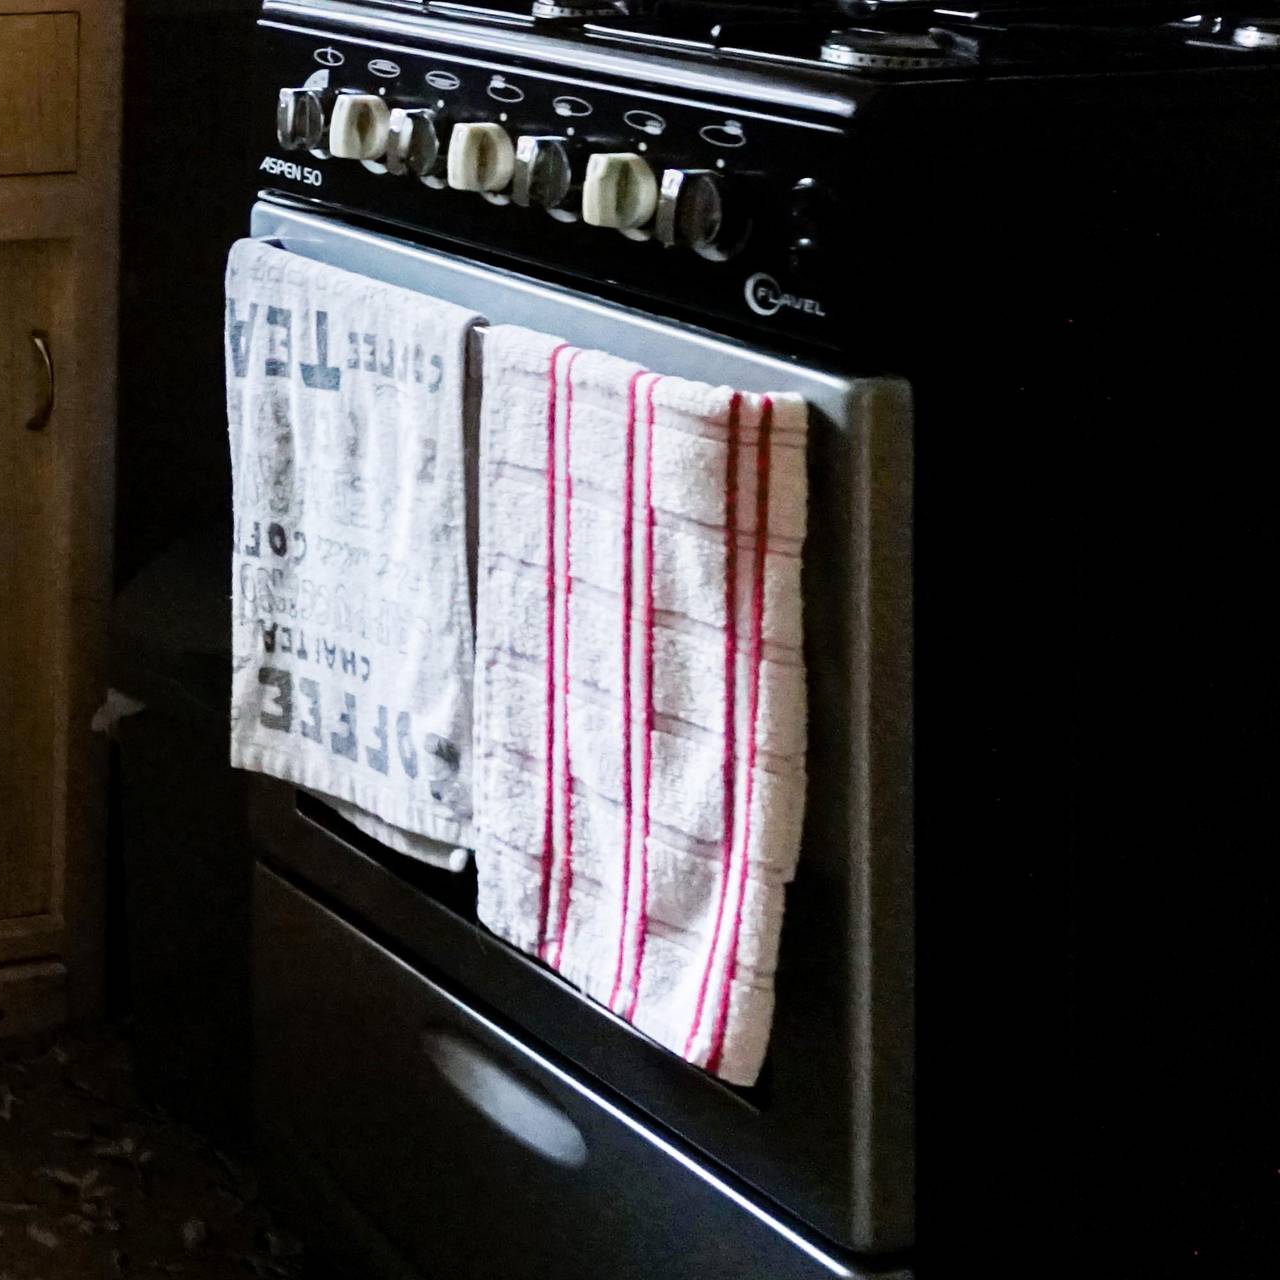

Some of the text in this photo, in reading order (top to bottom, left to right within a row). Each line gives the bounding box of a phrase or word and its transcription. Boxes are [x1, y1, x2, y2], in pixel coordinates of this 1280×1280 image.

[259, 156, 323, 187] ASPEN 50
[228, 298, 341, 392] TEA
